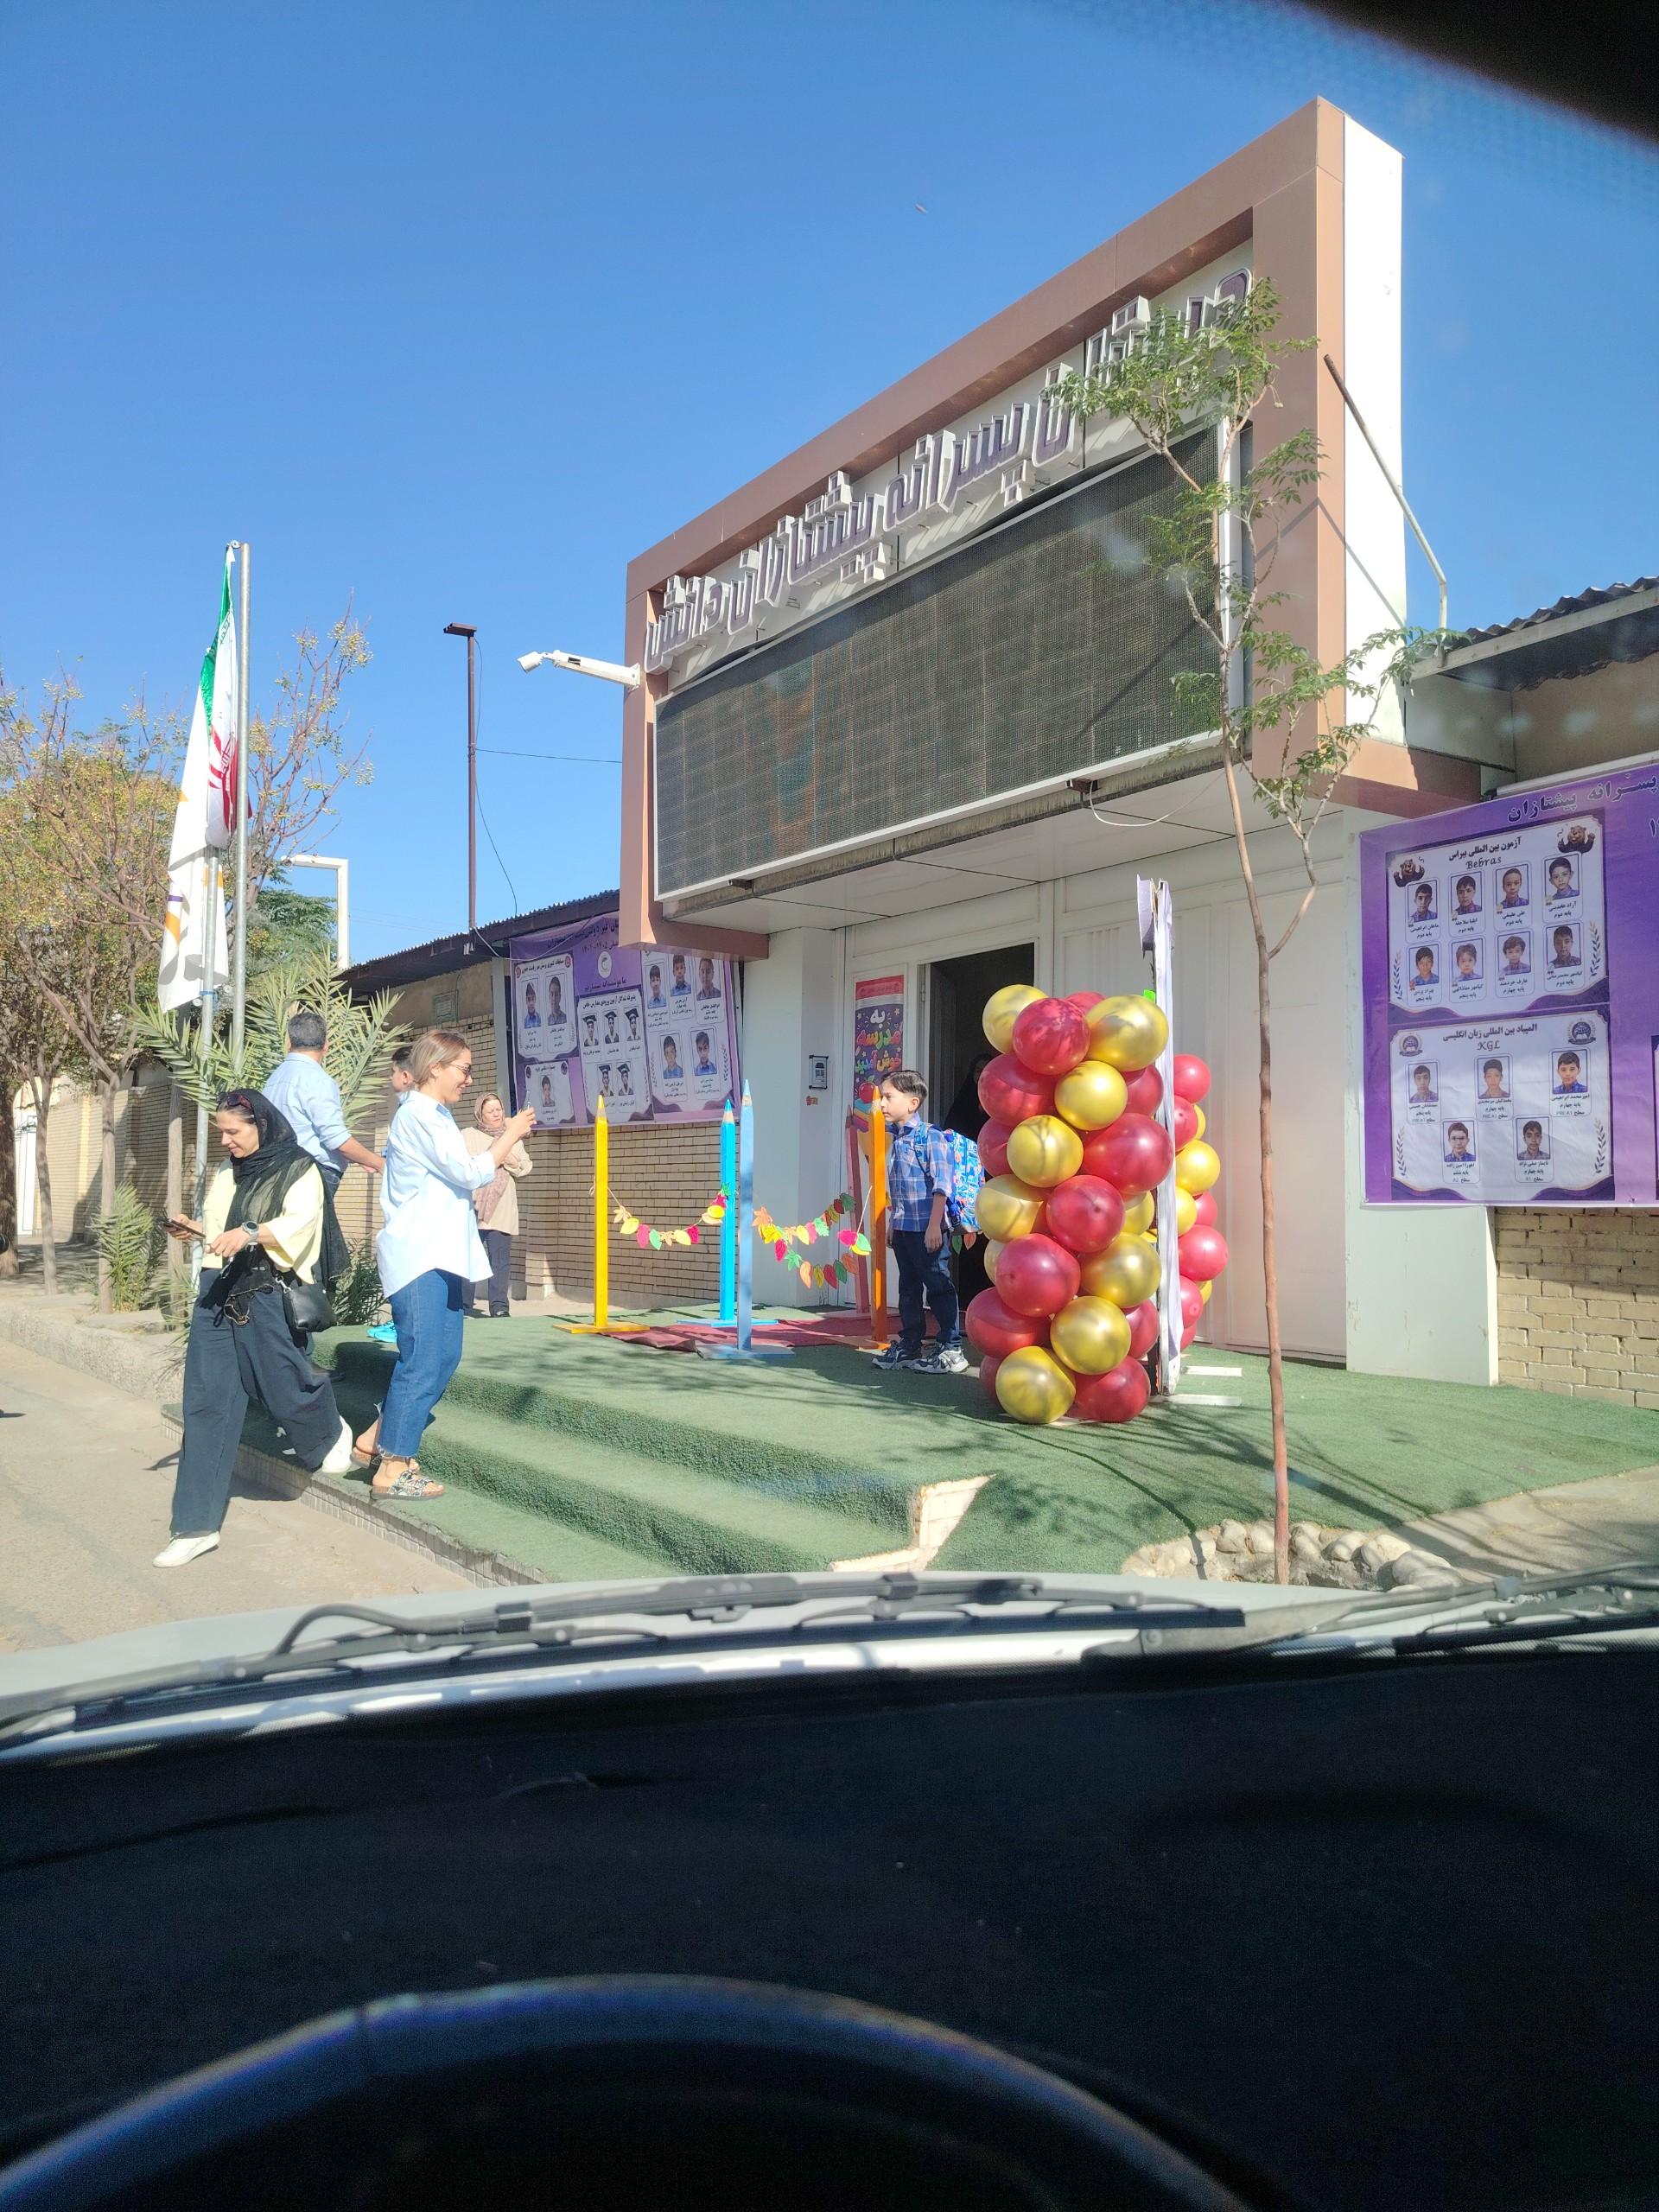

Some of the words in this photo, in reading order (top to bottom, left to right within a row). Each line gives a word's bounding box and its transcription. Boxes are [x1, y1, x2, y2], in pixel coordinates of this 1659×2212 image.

[883, 401, 1032, 532] پسرانه
[728, 469, 887, 636] پیشتازان
[644, 574, 728, 674] دانش
[1587, 776, 1657, 802] پسرانه
[1508, 792, 1576, 822] پیشتازان
[1468, 844, 1488, 857] المللی
[1489, 843, 1500, 854] بین
[1501, 836, 1522, 851] آزمون
[1465, 856, 1502, 870] Bebras
[869, 1008, 886, 1029] به
[1442, 1031, 1467, 1042] انگلیسی
[1467, 1030, 1482, 1039] زبان
[1483, 1027, 1503, 1038] المللی
[1504, 1026, 1516, 1036] بین
[1516, 1023, 1538, 1036] المپیاد
[856, 1028, 902, 1051] مدرسه
[876, 1050, 901, 1072] خوش
